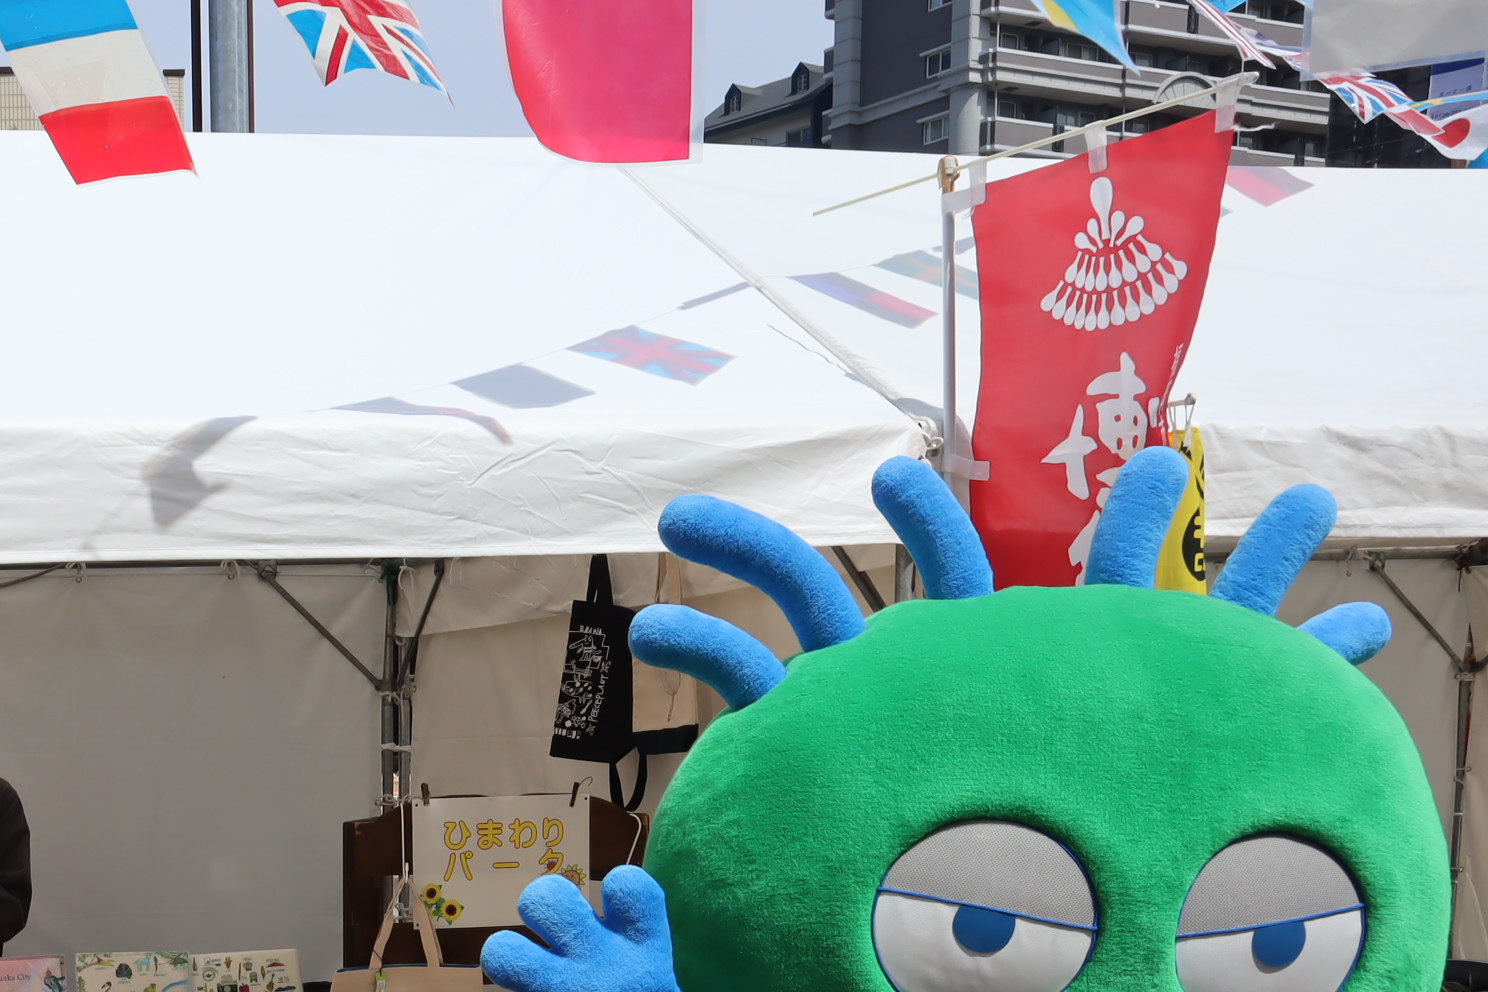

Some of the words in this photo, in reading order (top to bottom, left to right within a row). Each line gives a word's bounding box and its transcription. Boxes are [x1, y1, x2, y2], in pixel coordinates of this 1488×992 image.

[444, 817, 565, 850] ひまわり
[443, 848, 565, 882] パーク
[17, 973, 32, 981] City
